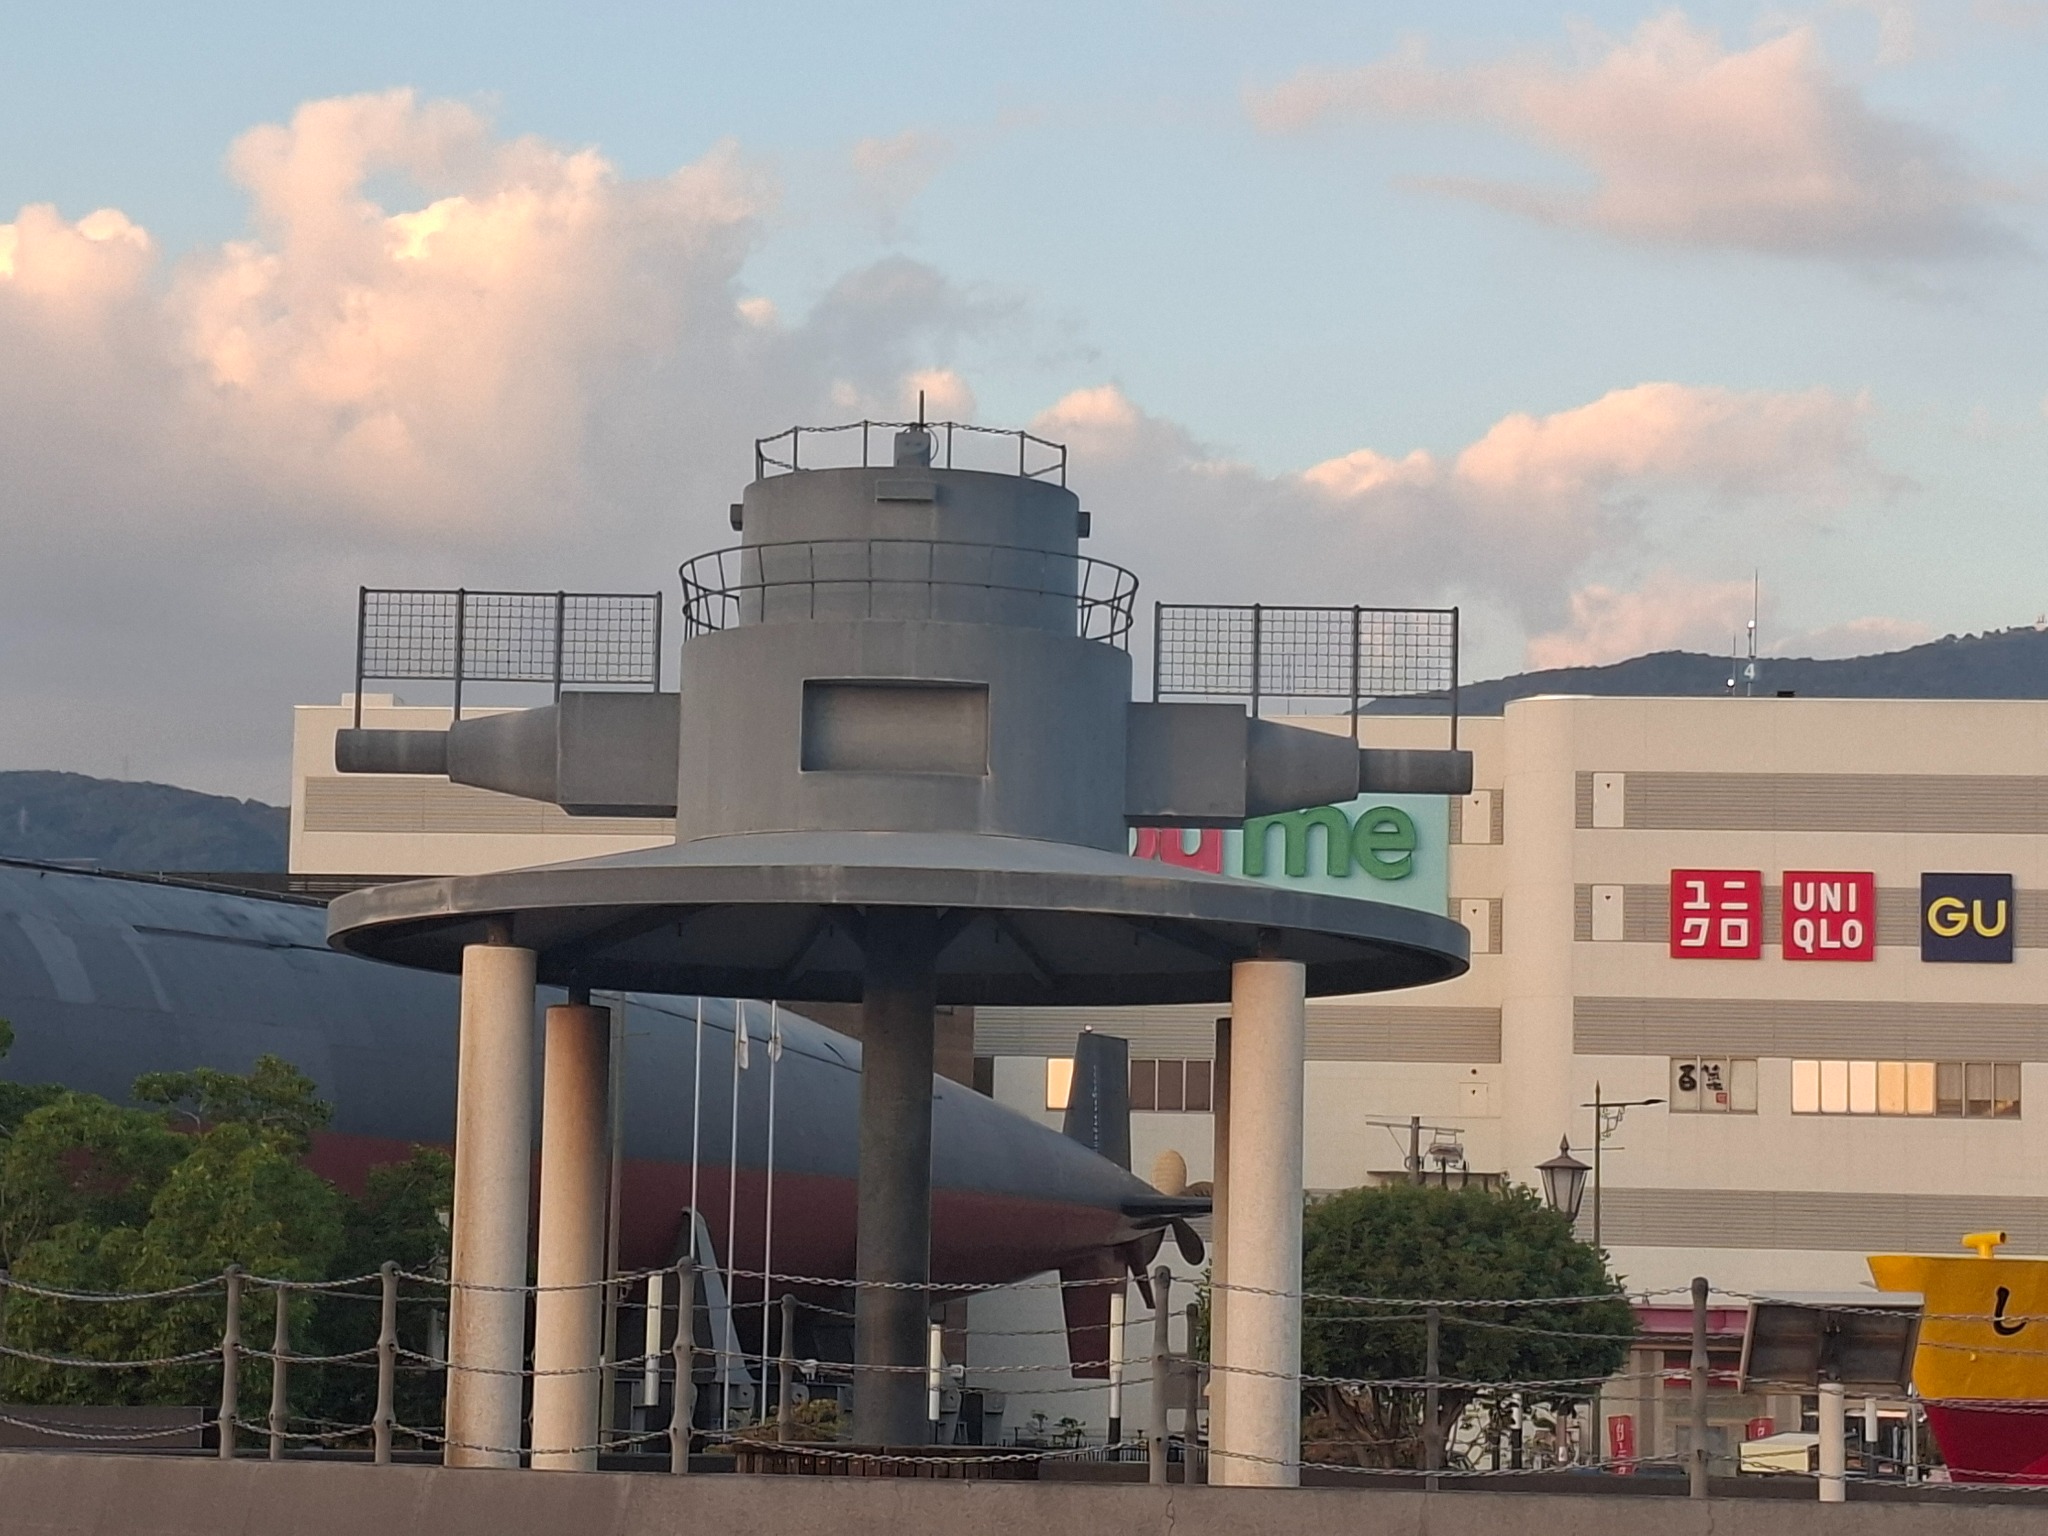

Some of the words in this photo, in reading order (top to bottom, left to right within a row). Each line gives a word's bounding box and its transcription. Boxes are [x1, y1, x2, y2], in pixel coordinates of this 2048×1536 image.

[1682, 880, 1749, 910] ユニ
[1793, 881, 1856, 912] UNI
[1927, 896, 2006, 937] GU
[1793, 918, 1863, 954] QLO
